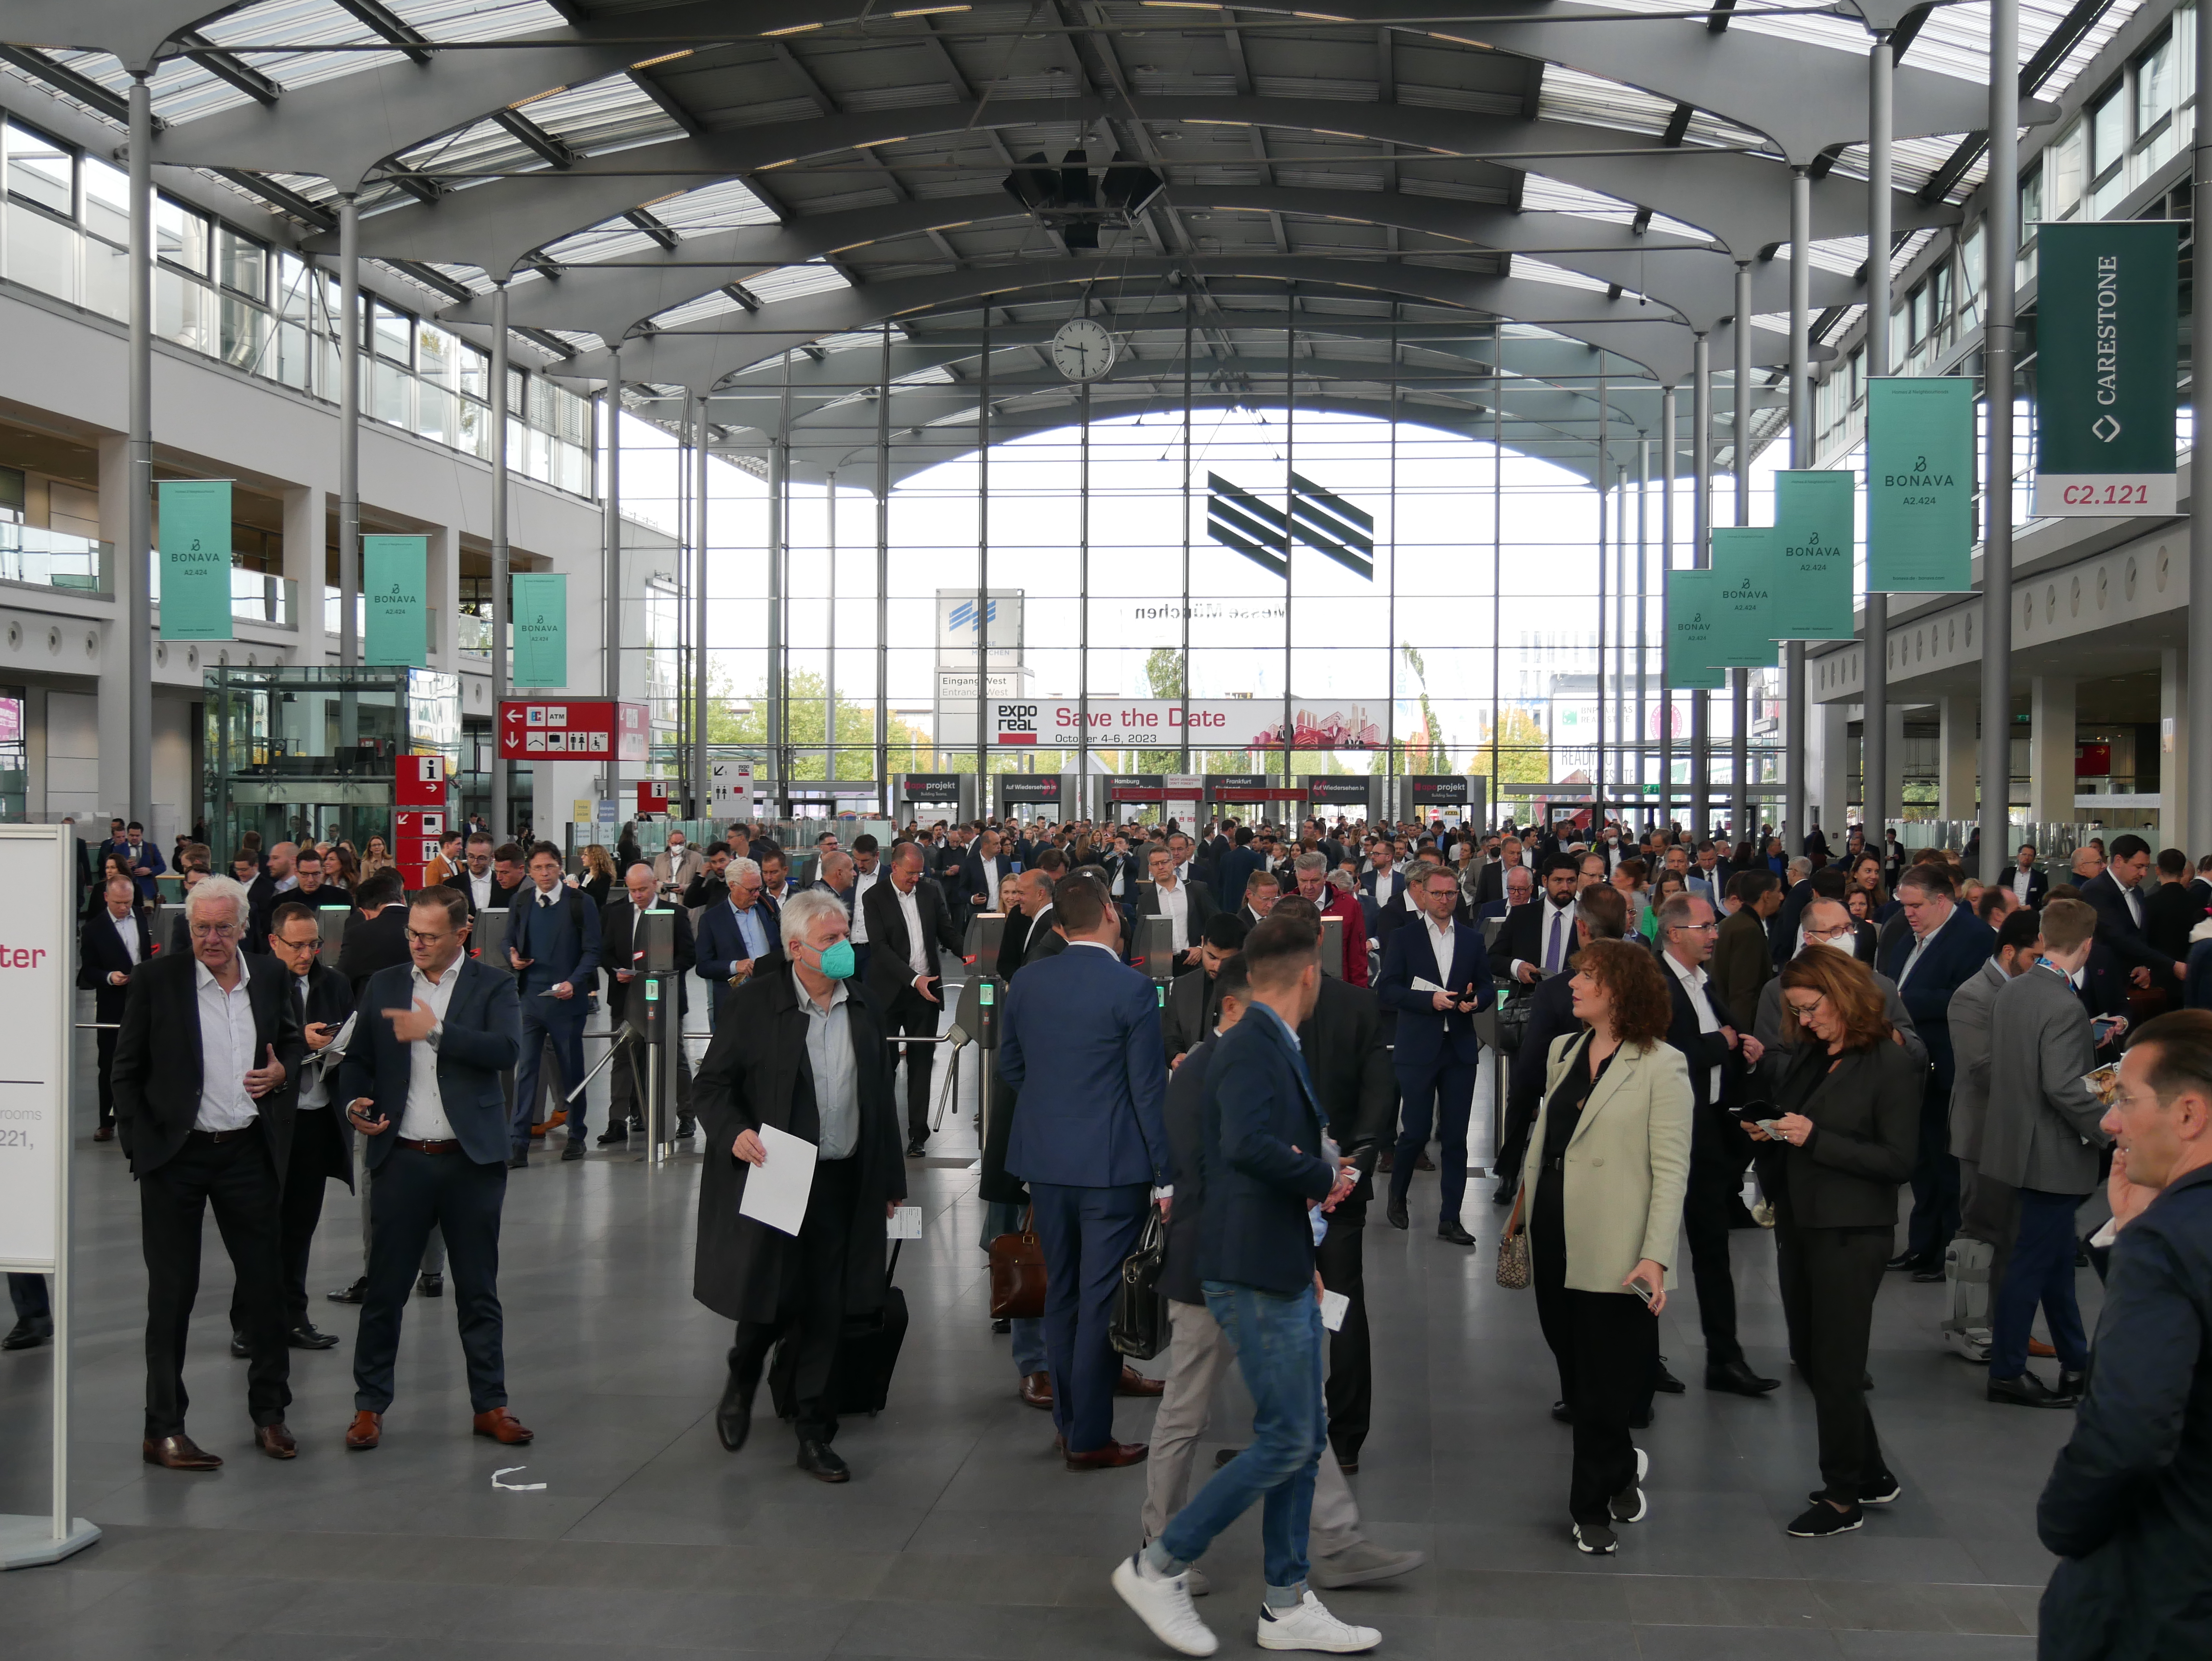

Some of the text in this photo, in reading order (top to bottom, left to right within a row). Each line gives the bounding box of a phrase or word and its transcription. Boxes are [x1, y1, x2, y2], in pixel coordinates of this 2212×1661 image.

[2097, 256, 2117, 405] CARESTONE
[1885, 475, 1954, 487] BONAVA
[2063, 485, 2148, 505] C2.121
[1903, 497, 1936, 505] A2.424
[1786, 547, 1840, 556] BONAVA
[171, 554, 220, 562] BONAVA
[943, 677, 979, 686] Eingang
[998, 705, 1038, 721] expo
[1055, 707, 1226, 727] Save the Date
[1055, 734, 1097, 743] Octoer
[1128, 734, 1157, 743] 2023
[910, 781, 955, 791] apoprojekt
[1422, 783, 1465, 792] apoprojekt
